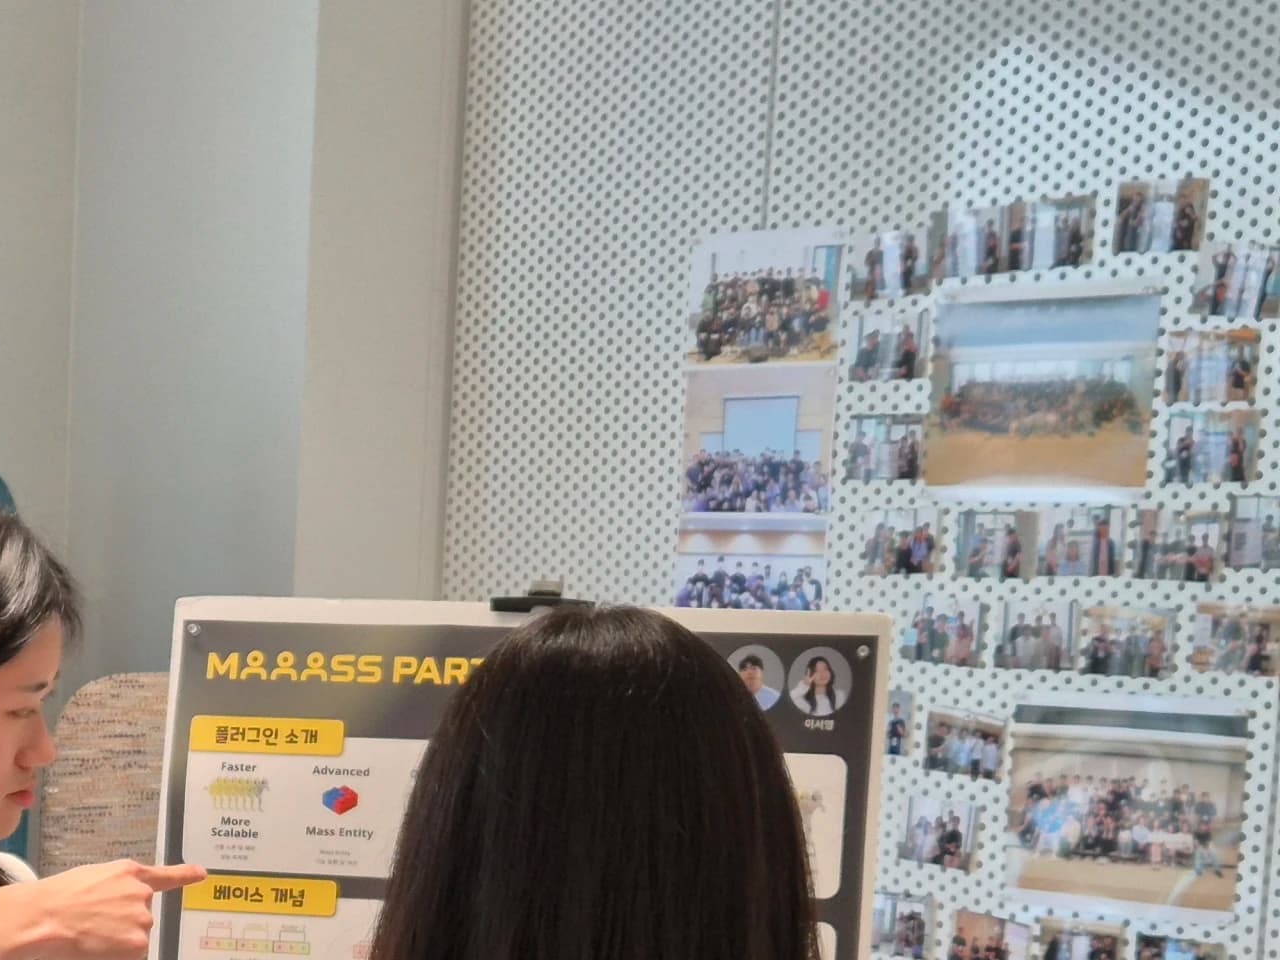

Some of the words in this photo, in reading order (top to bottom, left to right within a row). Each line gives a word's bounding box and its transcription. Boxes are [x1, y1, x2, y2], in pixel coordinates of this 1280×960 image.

[215, 725, 279, 747] 플러그인
[285, 728, 319, 745] 소개
[220, 761, 258, 773] Faster
[312, 765, 371, 777] Advanced
[220, 816, 251, 827] More
[210, 827, 259, 839] Scalable
[305, 826, 336, 837] Mass
[338, 827, 374, 840] Entity
[213, 884, 264, 903] 베이스
[270, 888, 305, 908] 개념
